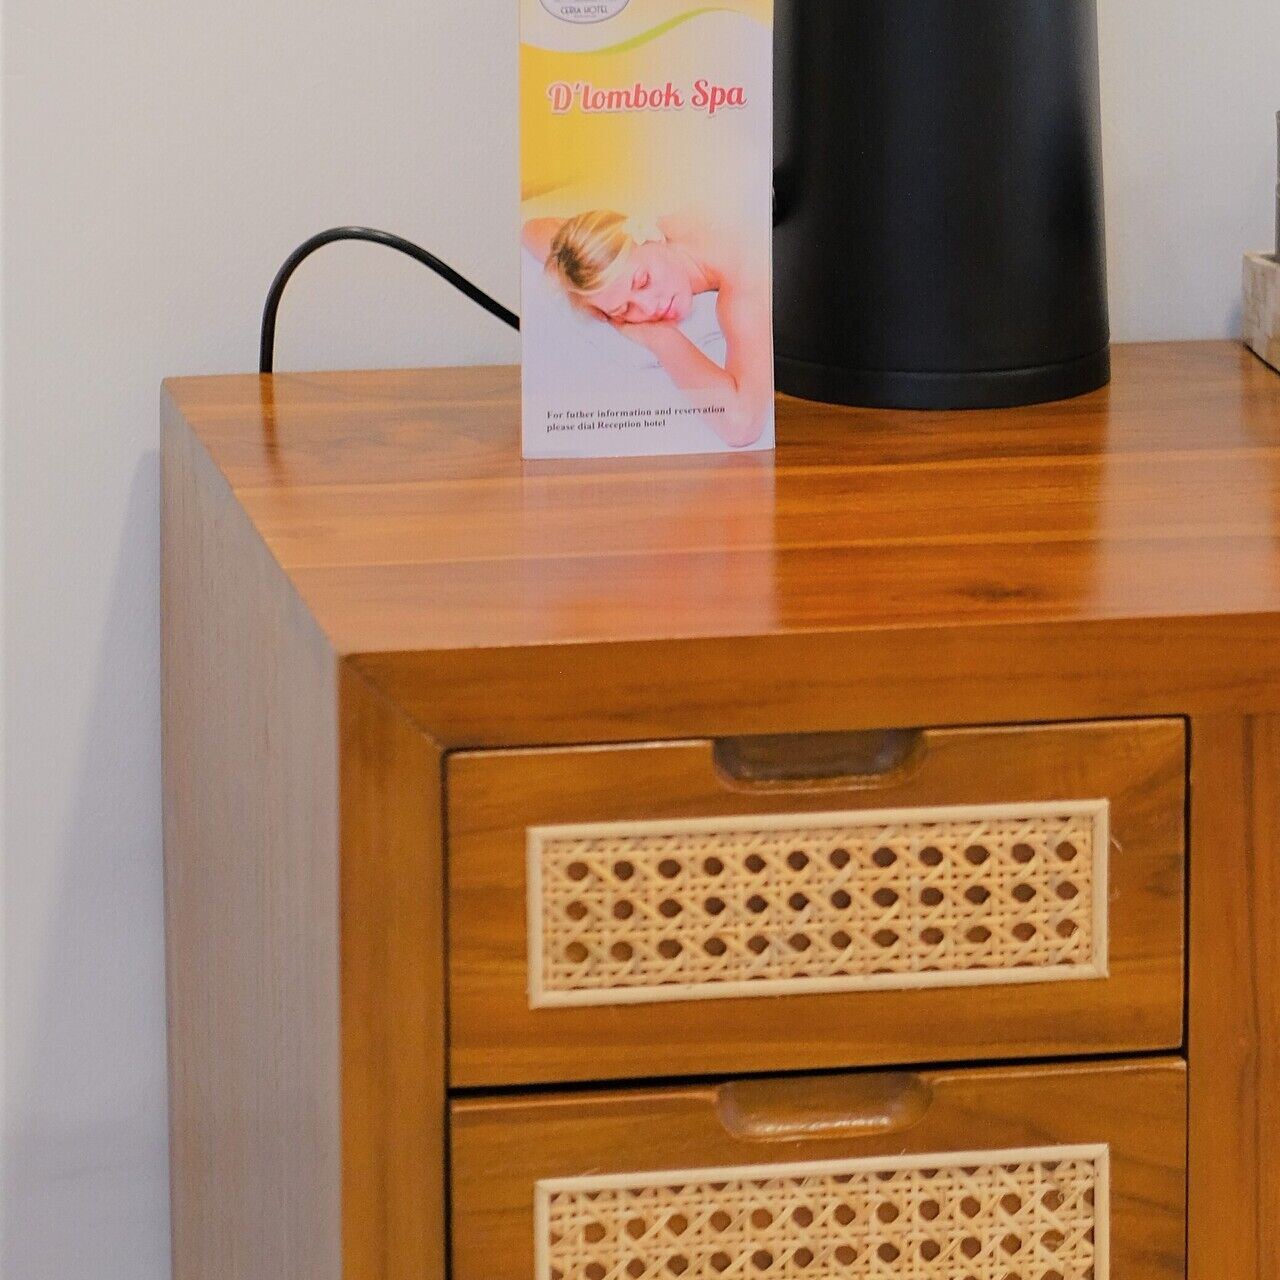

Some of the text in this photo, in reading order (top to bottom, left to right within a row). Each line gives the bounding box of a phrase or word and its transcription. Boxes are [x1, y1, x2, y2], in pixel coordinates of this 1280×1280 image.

[549, 79, 747, 115] D'lombok Spa
[547, 411, 563, 419] For
[597, 407, 652, 418] information
[655, 407, 672, 416] and
[674, 405, 725, 415] reservation
[546, 420, 666, 433] please dial Reception hotel
